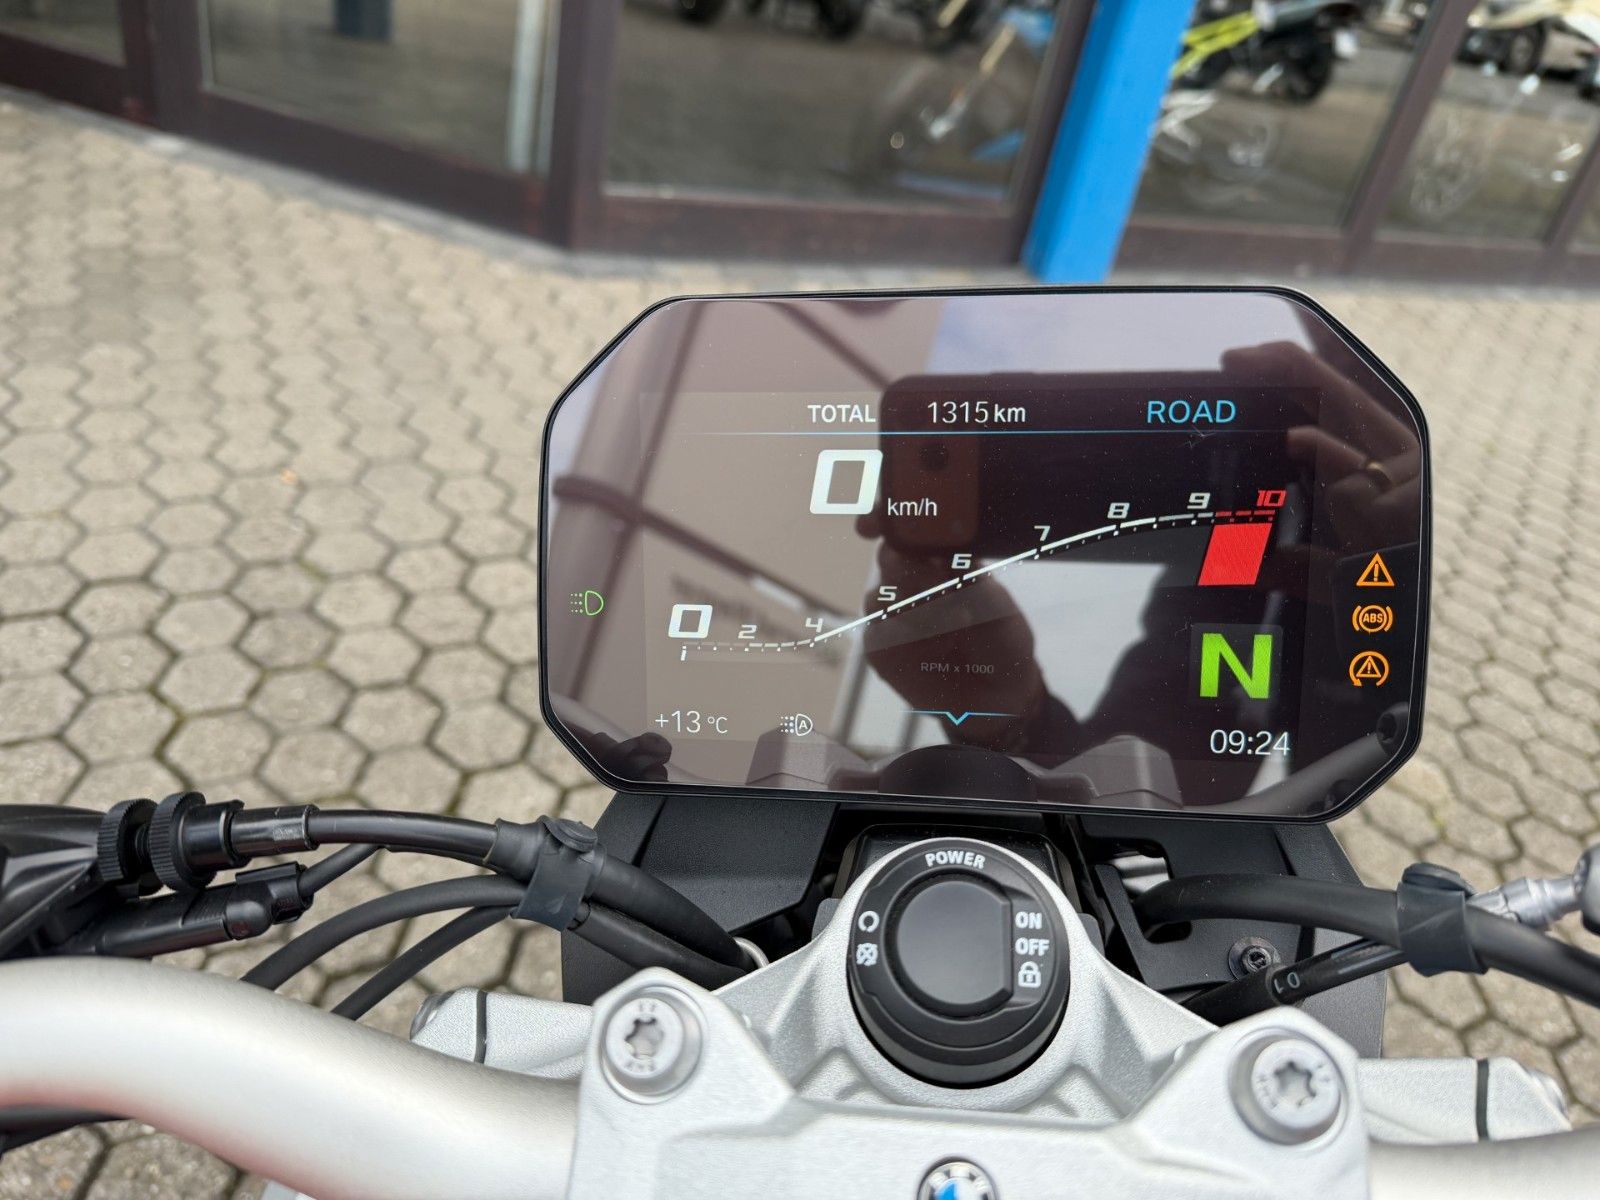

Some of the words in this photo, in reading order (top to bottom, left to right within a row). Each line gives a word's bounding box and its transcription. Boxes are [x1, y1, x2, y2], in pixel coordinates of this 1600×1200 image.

[807, 404, 876, 423] TOTAL
[927, 401, 989, 424] 1315
[994, 403, 1026, 423] km
[1147, 400, 1237, 424] ROAD
[810, 449, 883, 515] 0
[887, 498, 938, 517] km/h
[1187, 492, 1211, 509] 9
[1256, 489, 1287, 508] 10
[1107, 502, 1130, 519] 8
[1034, 525, 1051, 542] 7
[951, 553, 972, 570] 6
[877, 585, 898, 602] 5
[668, 604, 713, 639] 0
[805, 617, 824, 633] 4
[1362, 612, 1384, 625] ABS
[738, 624, 758, 640] 2
[920, 662, 949, 673] RPM
[964, 663, 995, 674] 1000
[1200, 633, 1273, 699] N
[654, 710, 701, 733] +13
[1209, 729, 1291, 756] 09:24
[924, 850, 986, 870] POWER
[1015, 911, 1043, 930] ON
[1015, 937, 1050, 957] OFF
